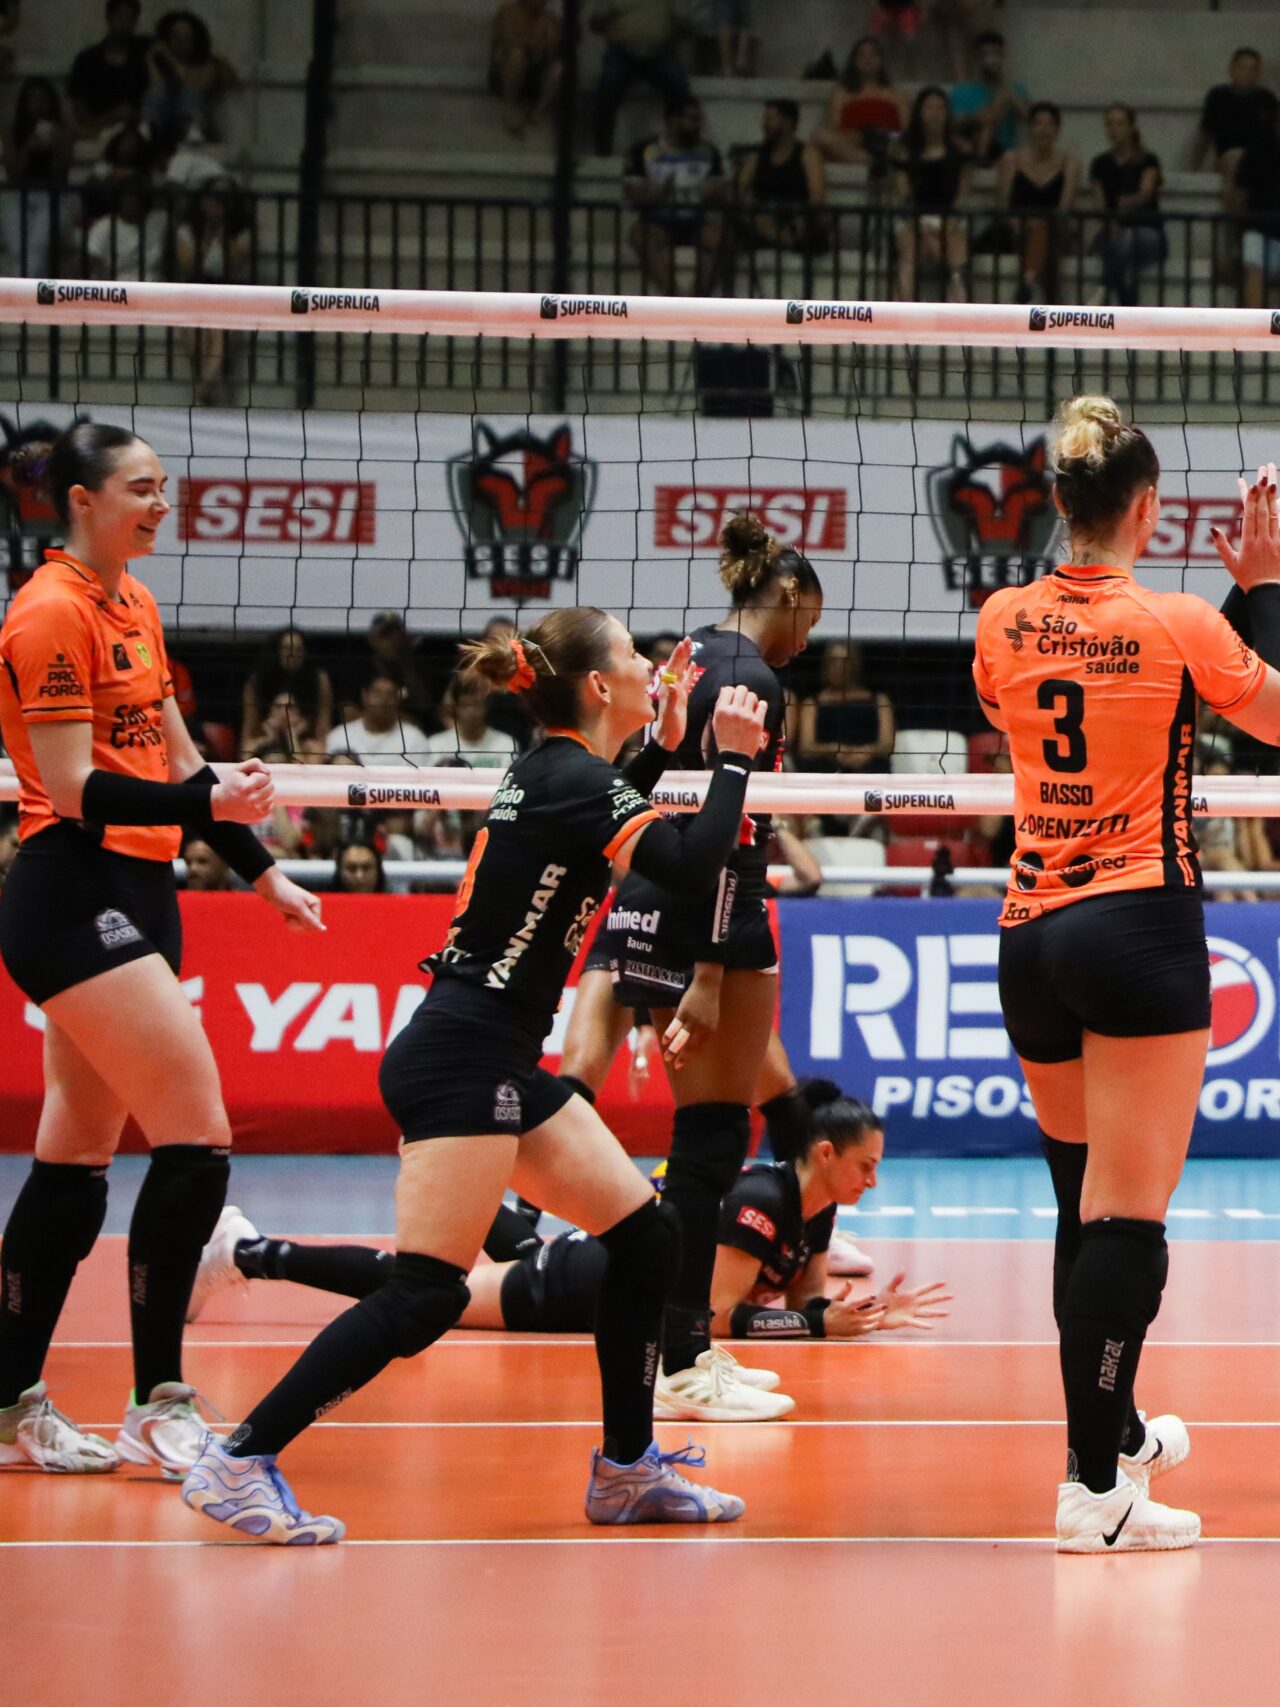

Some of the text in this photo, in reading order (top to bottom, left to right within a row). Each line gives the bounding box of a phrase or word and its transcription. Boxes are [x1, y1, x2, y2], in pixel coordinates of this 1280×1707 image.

[58, 286, 128, 305] SUPERLIGA
[311, 293, 380, 312] SUPERLIGA
[560, 299, 628, 318] SUPERLIGA
[806, 304, 873, 323] SUPERLIGA
[1048, 311, 1115, 331] SUPERLIGA
[193, 485, 360, 540] SESI
[474, 545, 573, 577] SESI
[1039, 614, 1078, 634] São
[1037, 634, 1141, 657] Cristóvão
[1085, 660, 1140, 674] saúde
[1037, 679, 1088, 773] 3
[369, 787, 441, 806] SUPERLIGA
[648, 790, 699, 807] PERLIGA
[885, 793, 955, 811] SUPERLIGA
[1040, 782, 1094, 806] BASSO
[607, 906, 661, 934] nimed
[627, 936, 653, 952] Bauru
[642, 1340, 658, 1388] nakal
[1098, 1337, 1125, 1393] nakal
